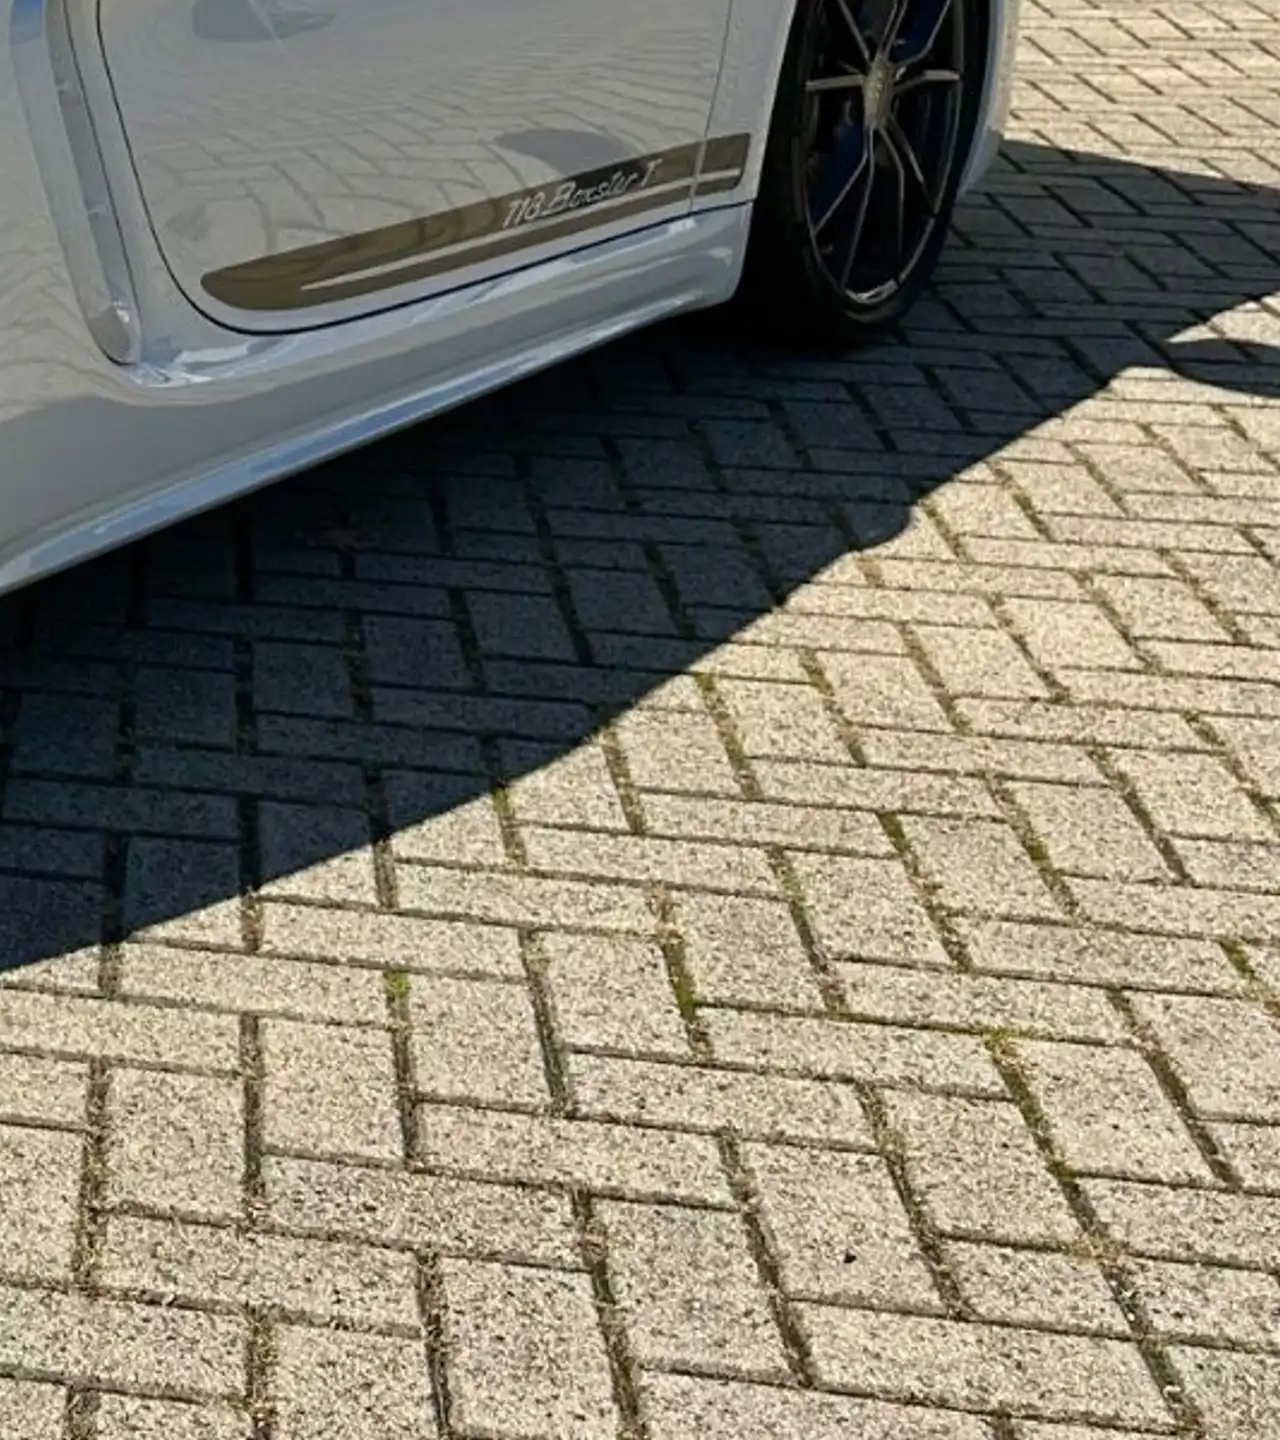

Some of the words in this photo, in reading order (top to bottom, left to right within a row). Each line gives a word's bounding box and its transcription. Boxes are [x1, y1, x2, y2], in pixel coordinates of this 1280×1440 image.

[503, 192, 546, 228] 718
[542, 170, 638, 214] Boxster
[641, 159, 662, 187] T
